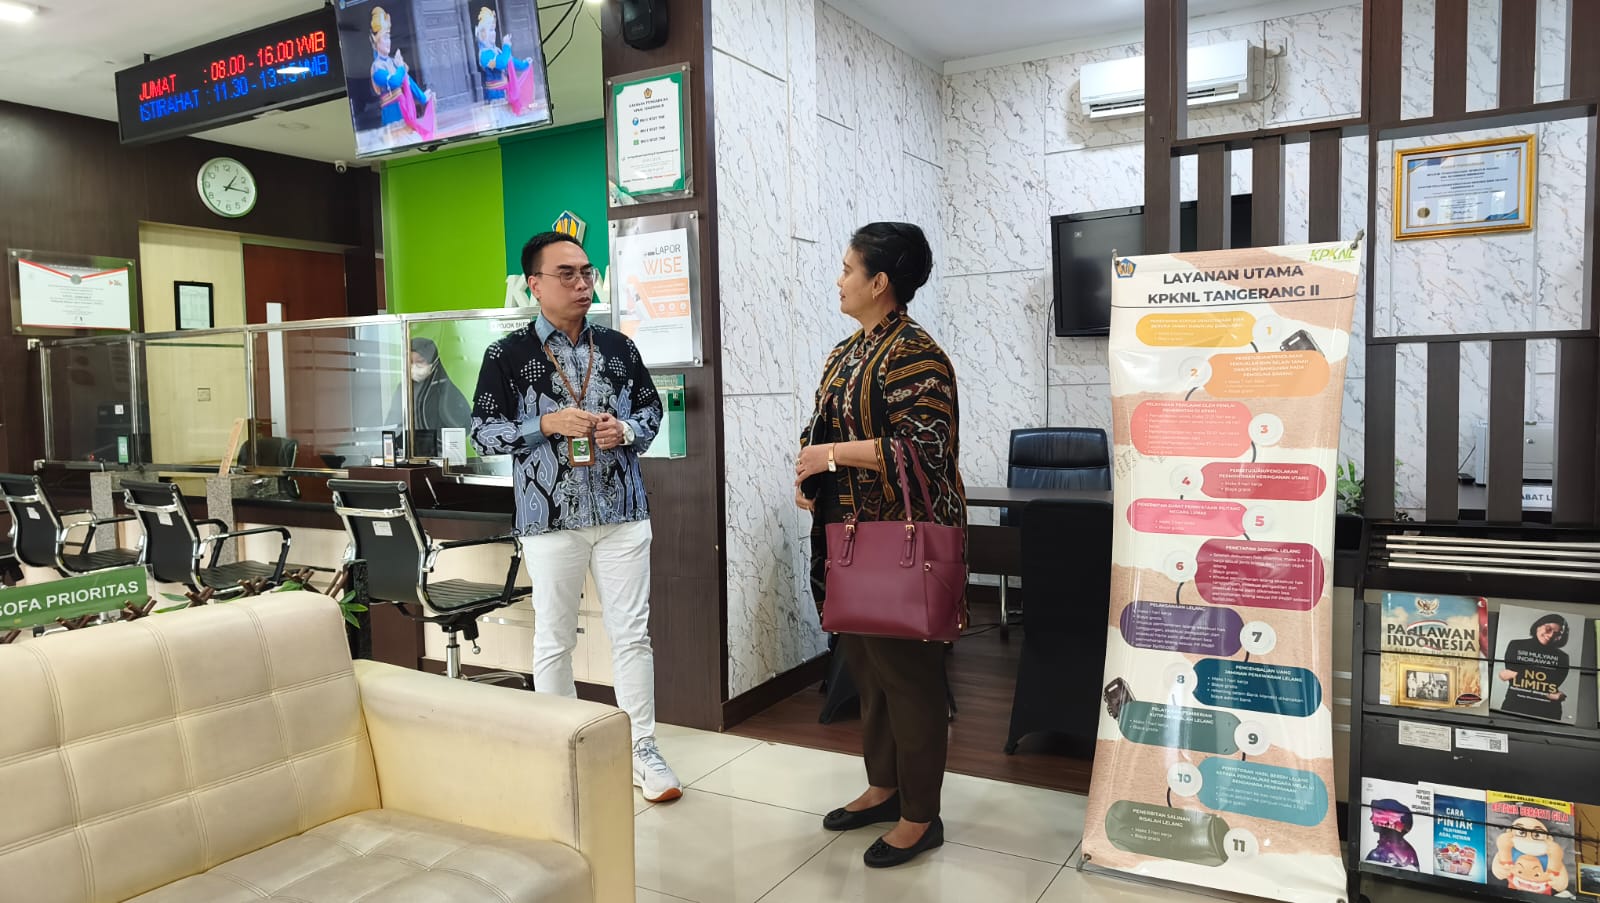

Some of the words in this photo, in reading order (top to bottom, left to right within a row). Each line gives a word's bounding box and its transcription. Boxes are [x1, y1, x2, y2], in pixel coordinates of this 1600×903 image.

[139, 74, 176, 101] JUMAT
[211, 54, 246, 81] 08.00
[257, 39, 293, 68] 16.00
[297, 31, 325, 58] WIB
[139, 89, 200, 122] ISTIRAHAT
[214, 76, 248, 103] 11.30
[298, 54, 329, 80] WIB
[655, 244, 680, 255] LAPOR
[1309, 248, 1355, 262] KPKNL
[643, 256, 682, 275] WISE
[1163, 272, 1239, 284] LAYANAN
[1244, 265, 1304, 280] UTAMA
[1148, 292, 1200, 304] KPKNL
[1204, 287, 1305, 302] TANGERANG
[1311, 285, 1319, 296] II
[1266, 326, 1272, 335] 1
[1191, 368, 1198, 377] 2
[1260, 425, 1268, 433] 3
[1255, 516, 1265, 526] 5
[1176, 562, 1184, 570] 6
[0, 598, 42, 617] OFA
[46, 581, 139, 609] PRIORITAS
[1252, 632, 1262, 642] 7
[1387, 624, 1475, 640] PAHLAWAN
[1387, 635, 1476, 652] INDONESIA
[1517, 656, 1558, 665] INDRAWATI
[1529, 652, 1558, 661] MULYANI
[1177, 675, 1185, 684] 8
[1524, 669, 1546, 681] NO
[1513, 677, 1557, 693] LIMITS
[1248, 733, 1258, 745] 9
[1178, 773, 1191, 783] 10
[1167, 813, 1191, 822] SALINAN
[1446, 808, 1464, 817] CARA
[1233, 839, 1245, 852] 11
